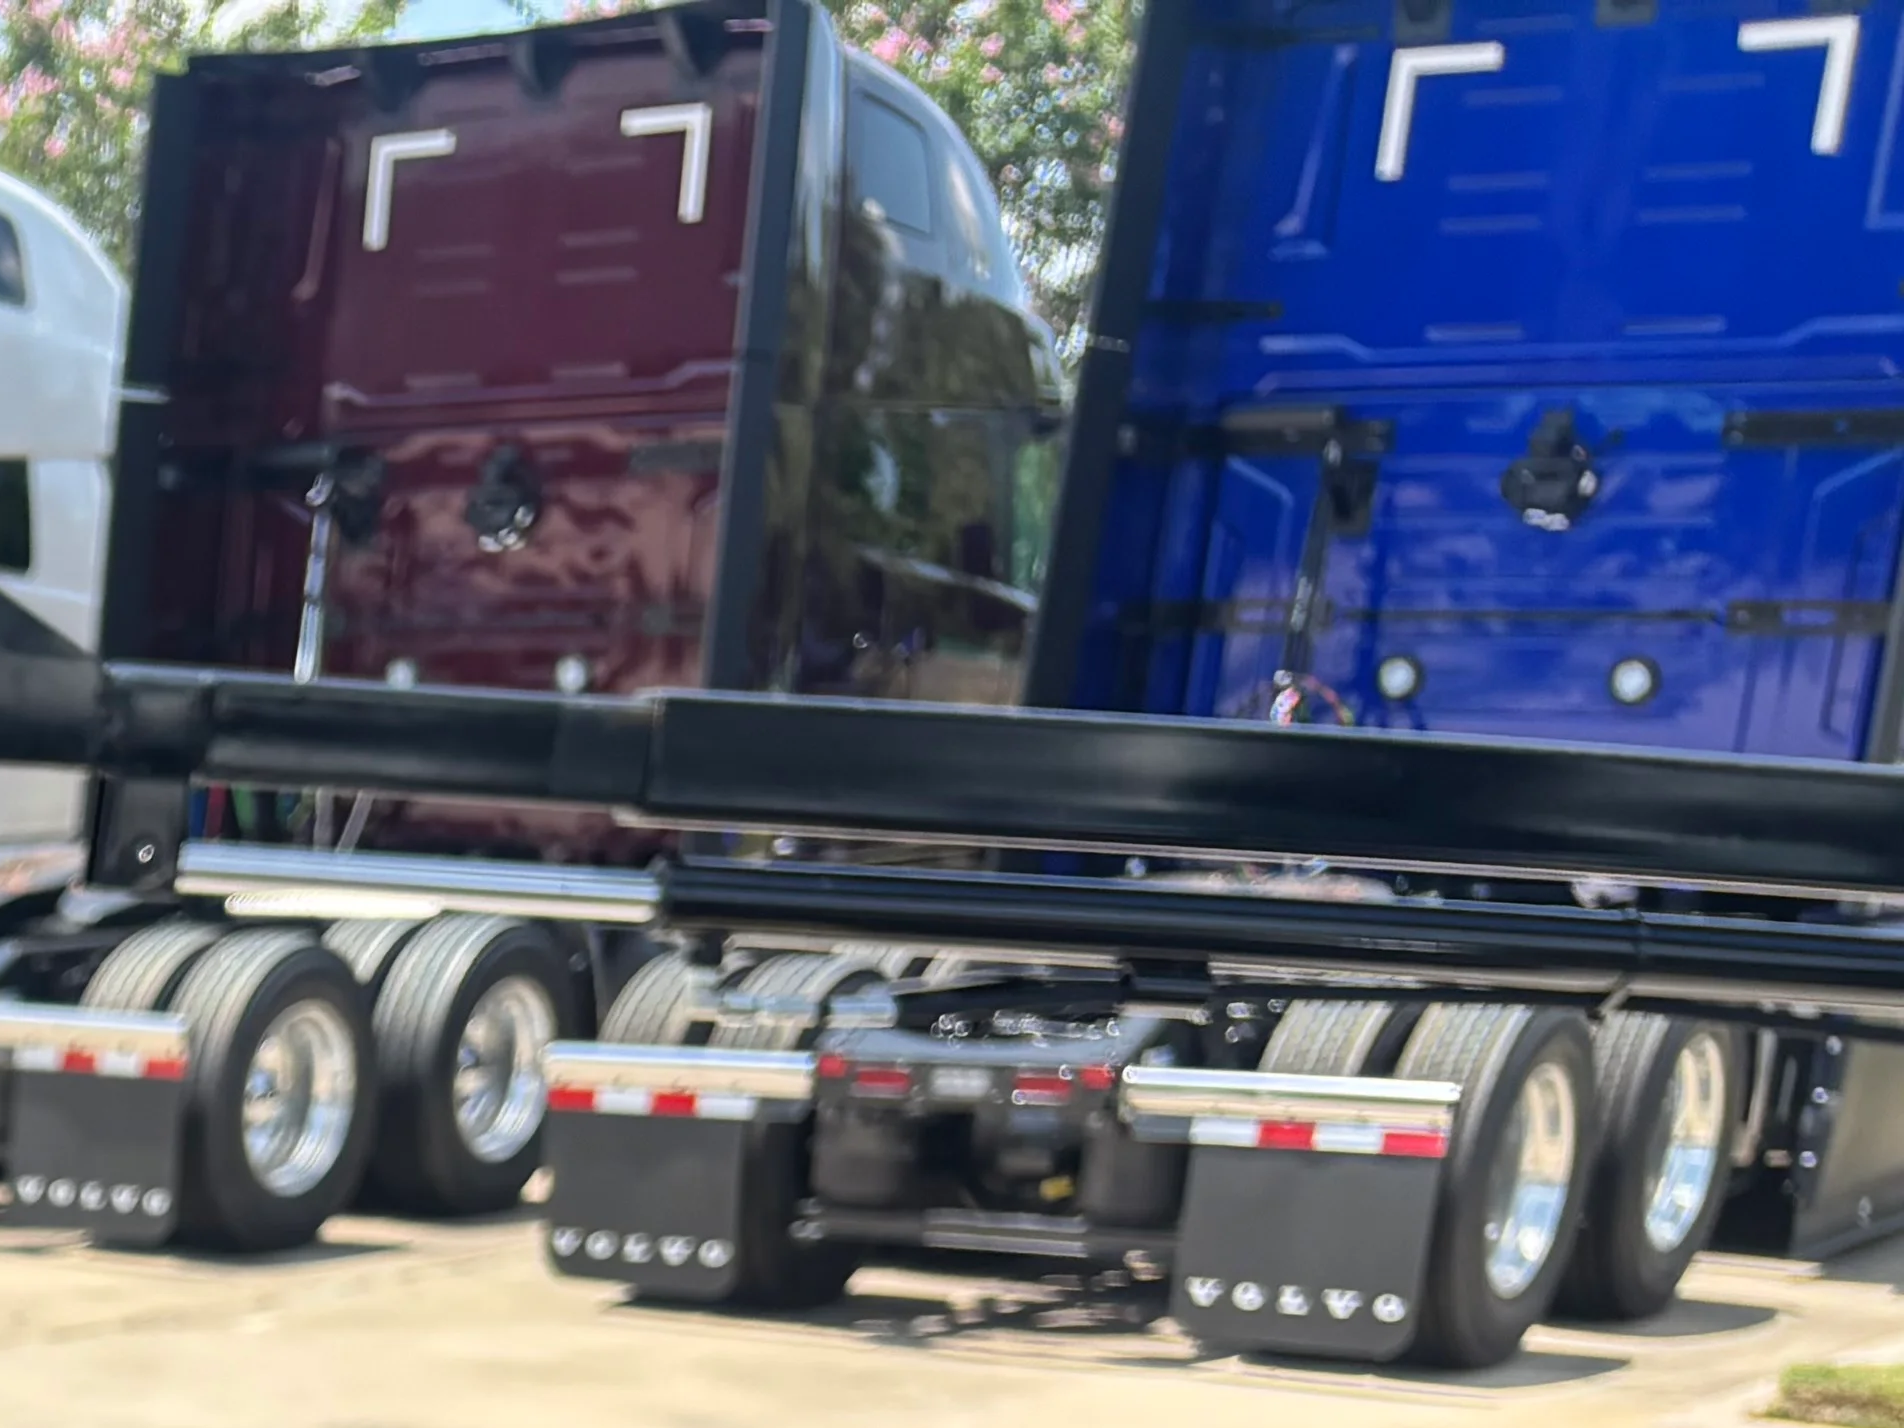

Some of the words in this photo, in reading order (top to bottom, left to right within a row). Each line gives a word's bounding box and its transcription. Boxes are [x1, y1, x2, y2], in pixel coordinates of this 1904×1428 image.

[15, 1173, 174, 1217] VOLVO
[549, 1226, 734, 1272] VOLVO
[1184, 1275, 1409, 1324] VOLVO
